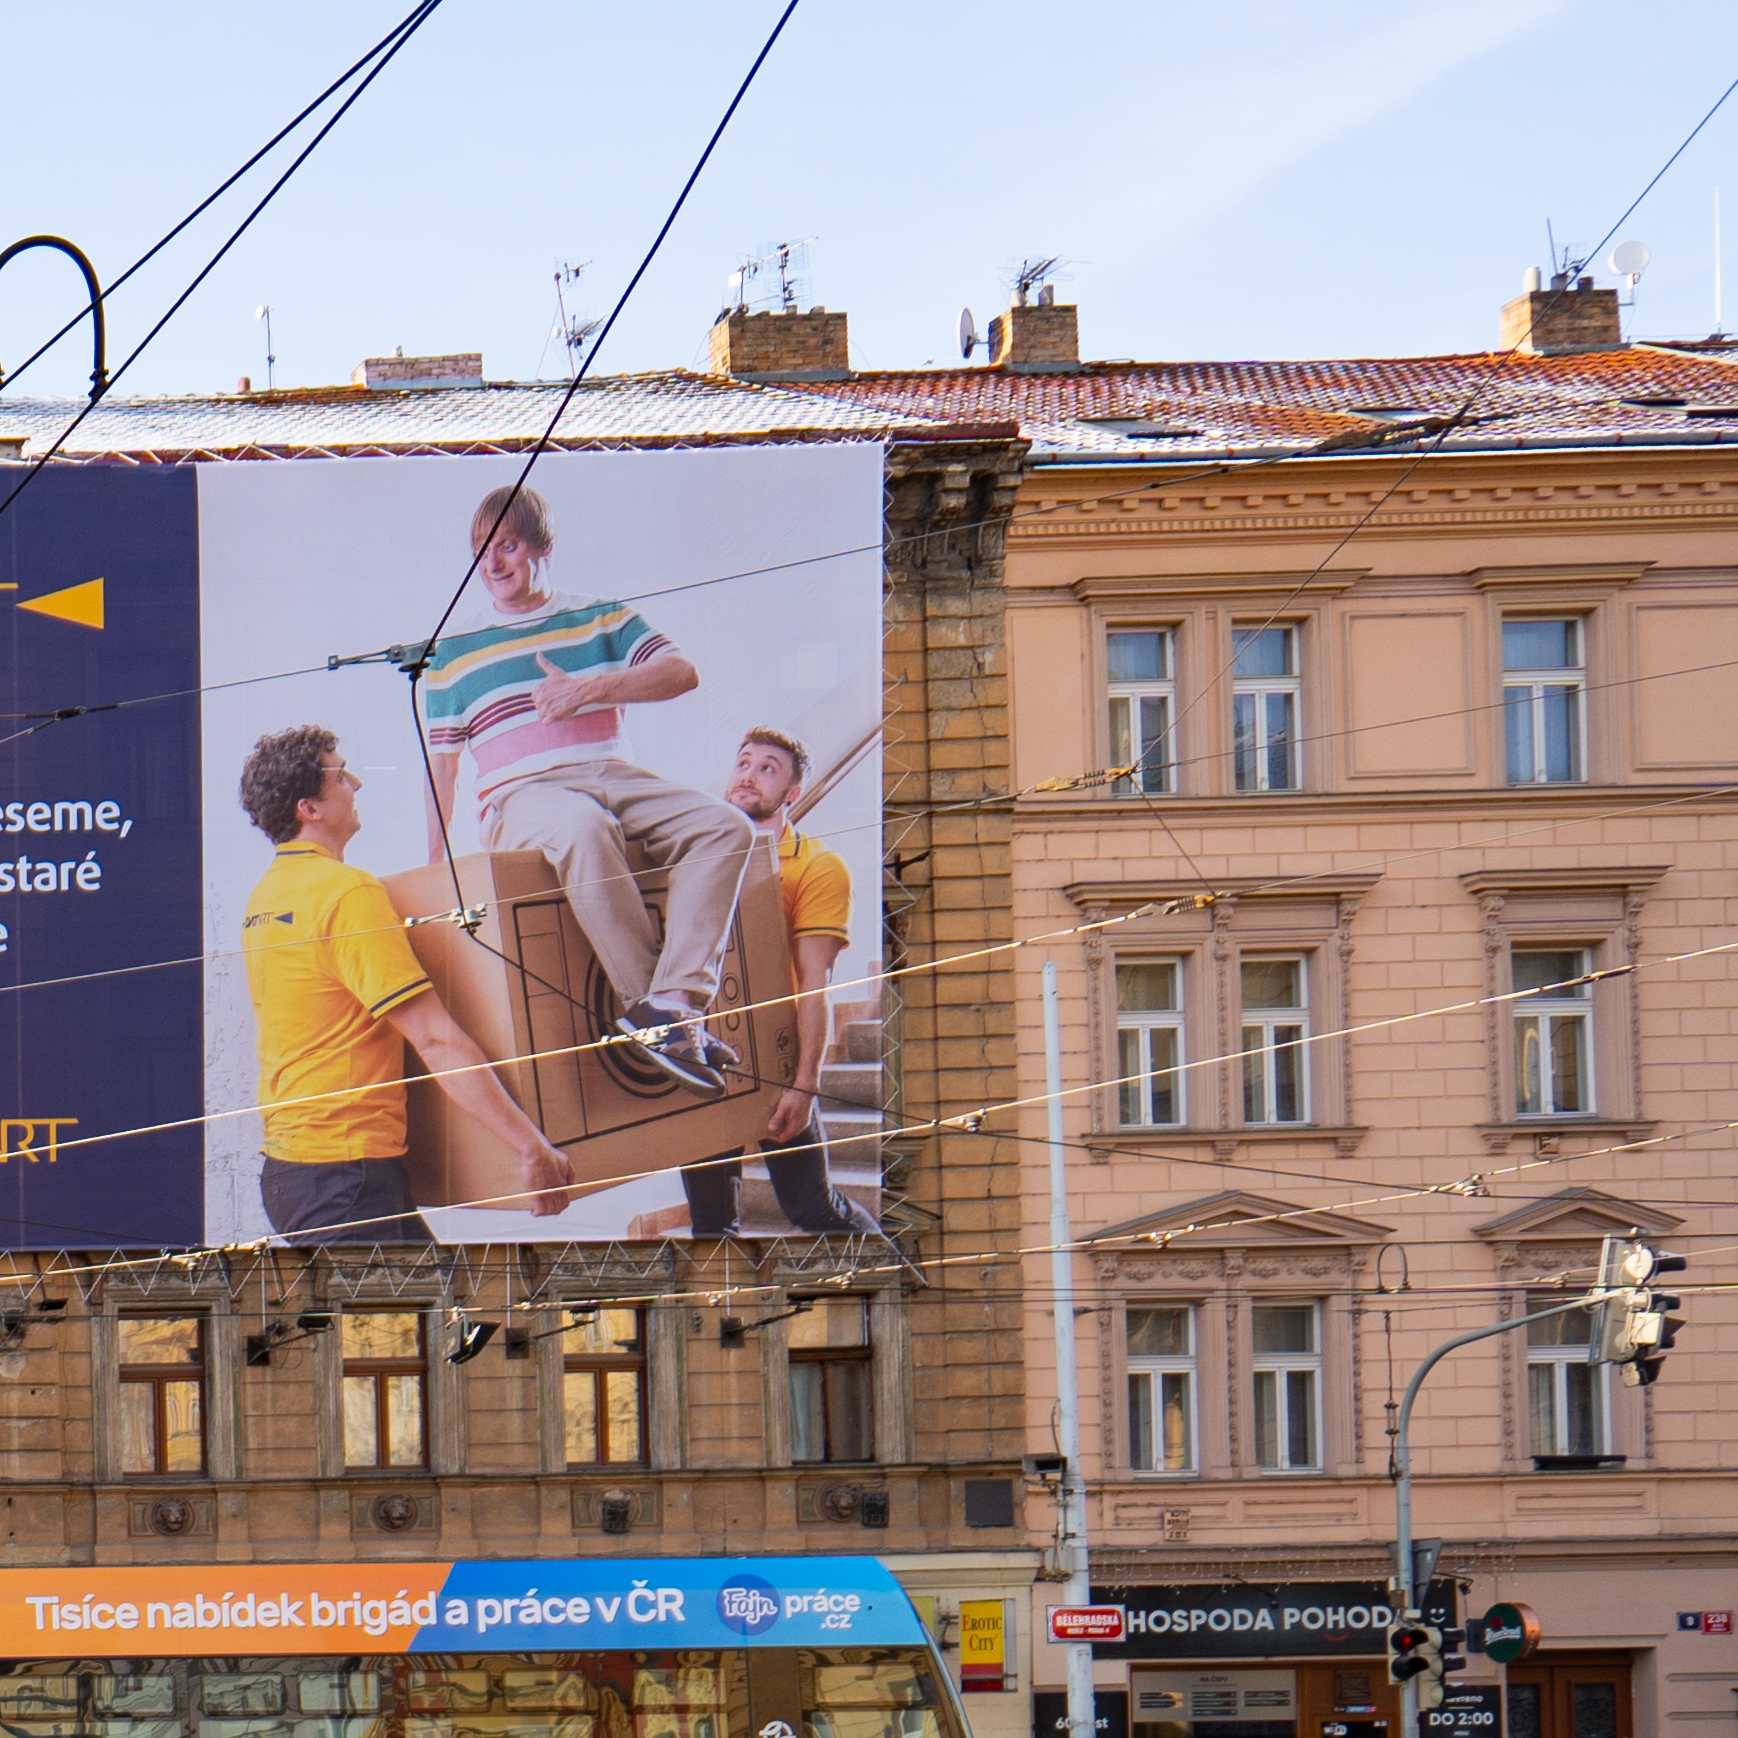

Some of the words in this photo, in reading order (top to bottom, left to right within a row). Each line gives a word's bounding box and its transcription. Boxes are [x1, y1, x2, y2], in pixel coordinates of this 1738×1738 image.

[25, 1593, 139, 1630] Tisíce
[147, 1592, 306, 1629] nabídek
[311, 1590, 437, 1635] brigád
[445, 1597, 469, 1625] a
[478, 1588, 590, 1632] práce
[598, 1597, 621, 1623] v
[627, 1579, 685, 1622] ČR
[723, 1588, 778, 1622] Fajn
[785, 1588, 861, 1618] práce
[820, 1612, 852, 1629] .cz
[1127, 1608, 1275, 1634] HOSPODA
[1429, 1713, 1454, 1725] DO
[1458, 1712, 1494, 1725] 2:00
